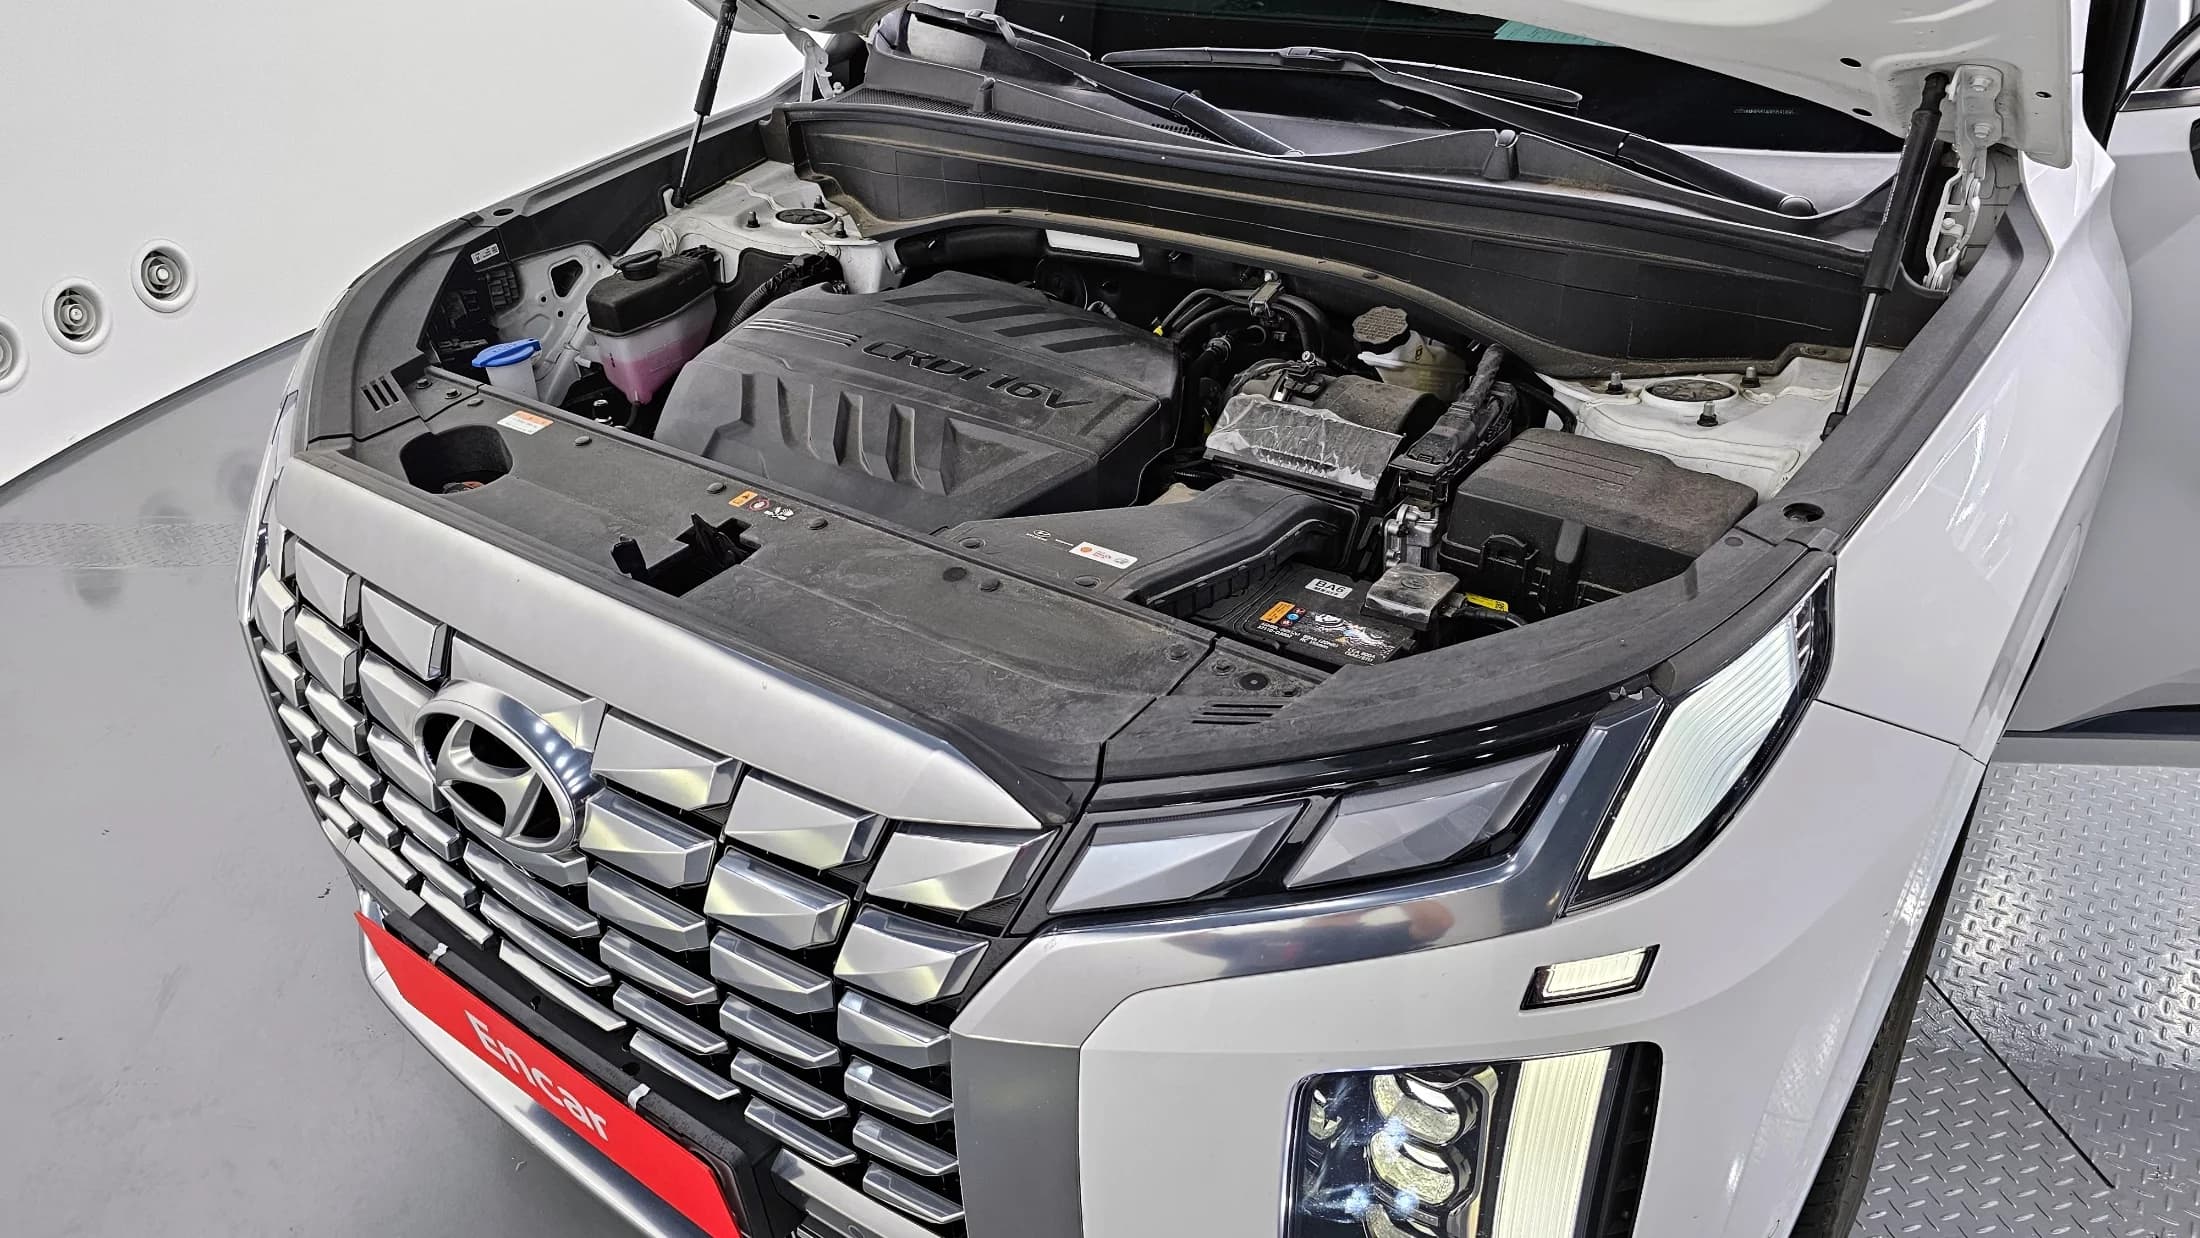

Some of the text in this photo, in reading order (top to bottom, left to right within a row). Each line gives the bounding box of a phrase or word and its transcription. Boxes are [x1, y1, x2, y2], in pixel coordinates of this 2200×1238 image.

[986, 373, 1094, 409] 16V
[1315, 580, 1346, 593] BA6
[464, 1009, 609, 1141] Encar
